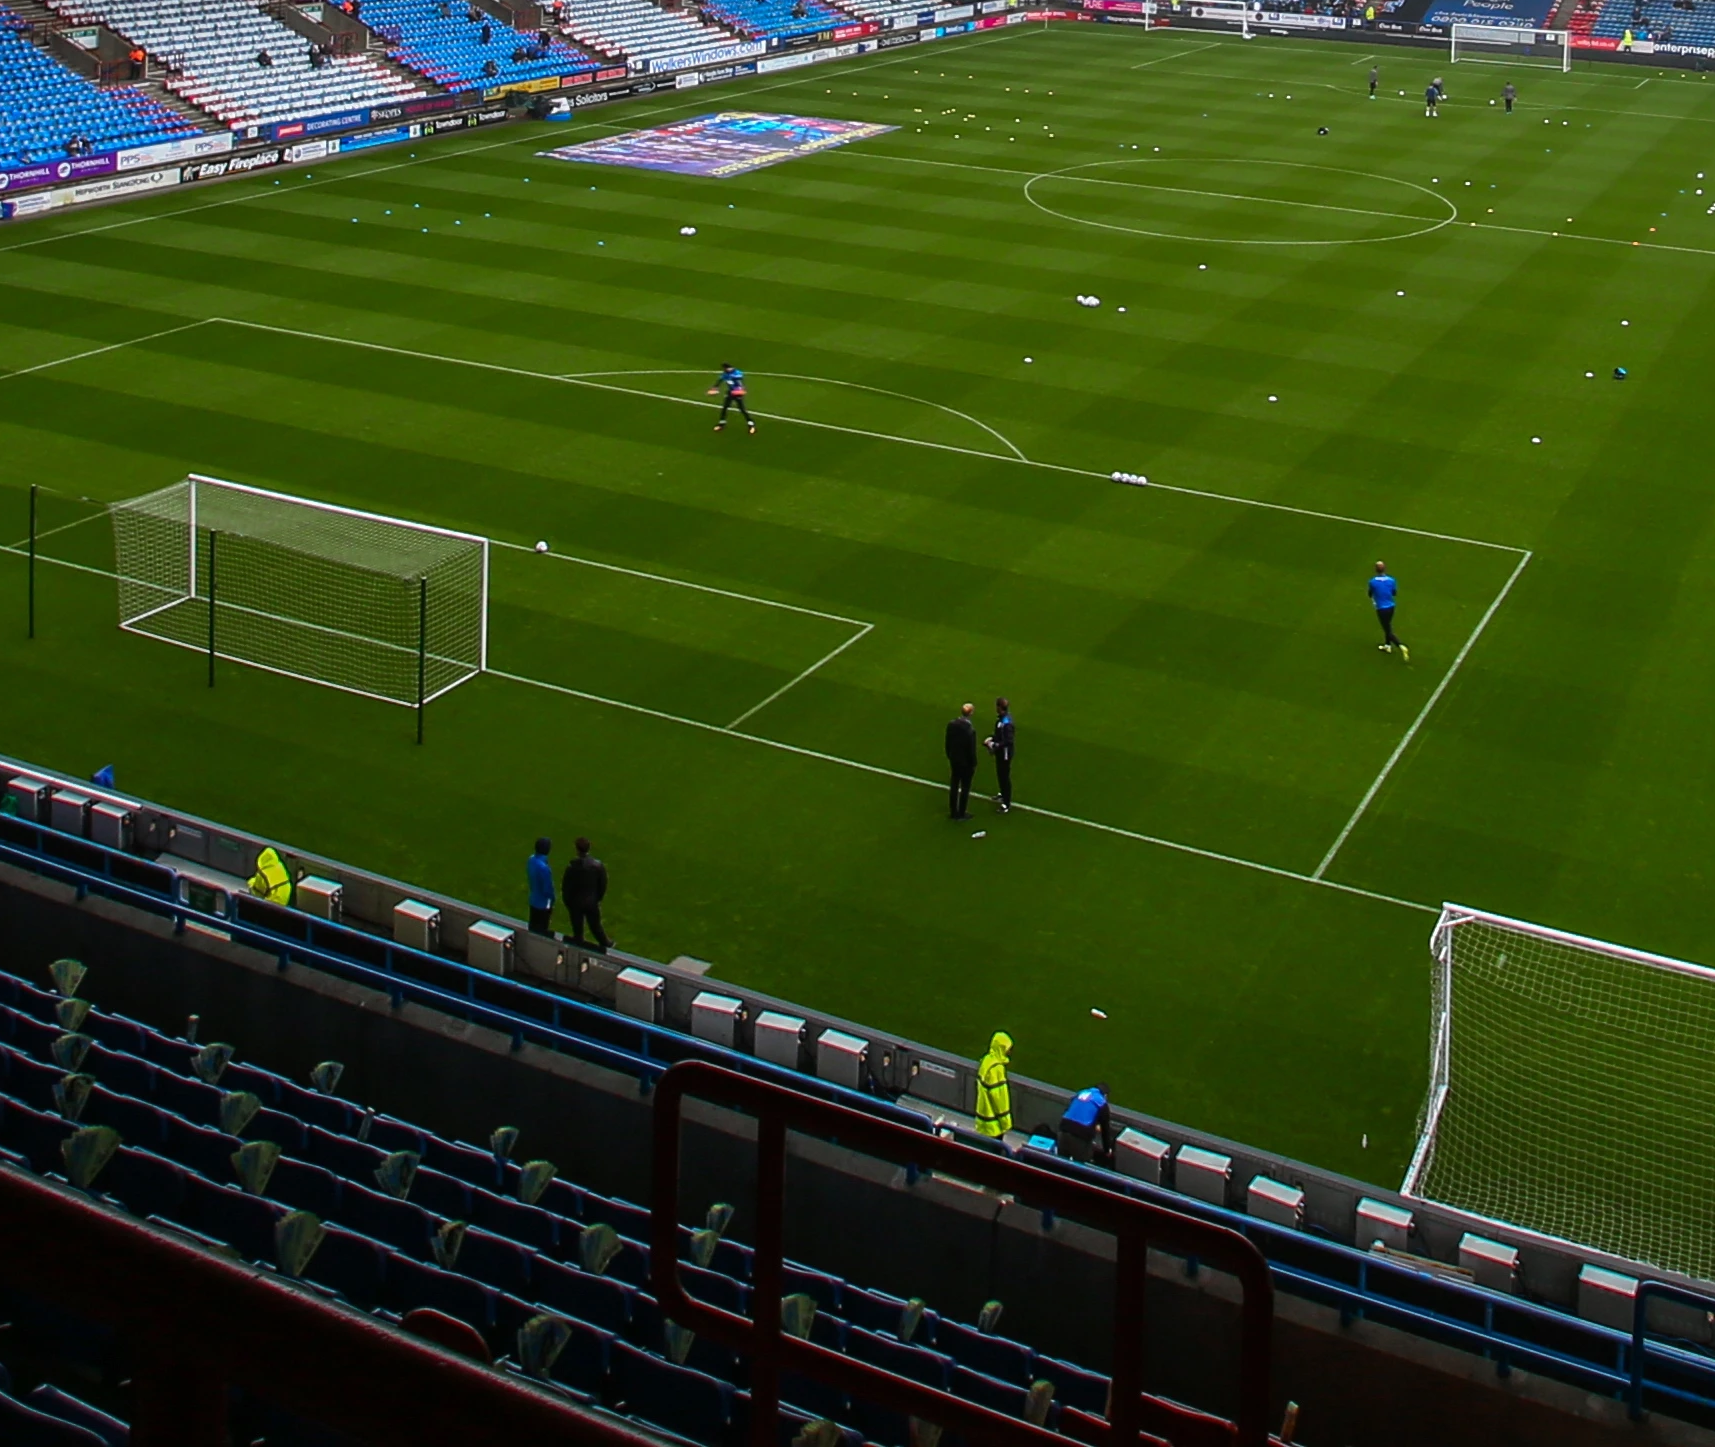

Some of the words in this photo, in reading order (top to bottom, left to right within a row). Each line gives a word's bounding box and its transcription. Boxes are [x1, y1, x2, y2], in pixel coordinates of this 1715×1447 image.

[1463, 0, 1514, 11] People
[652, 40, 762, 73] WalkersWindows.com
[576, 90, 608, 107] Solicitors
[307, 119, 341, 131] DECORATING
[72, 157, 110, 170] THORNHILL
[198, 161, 228, 176] Easy
[9, 168, 50, 181] THORNHILL
